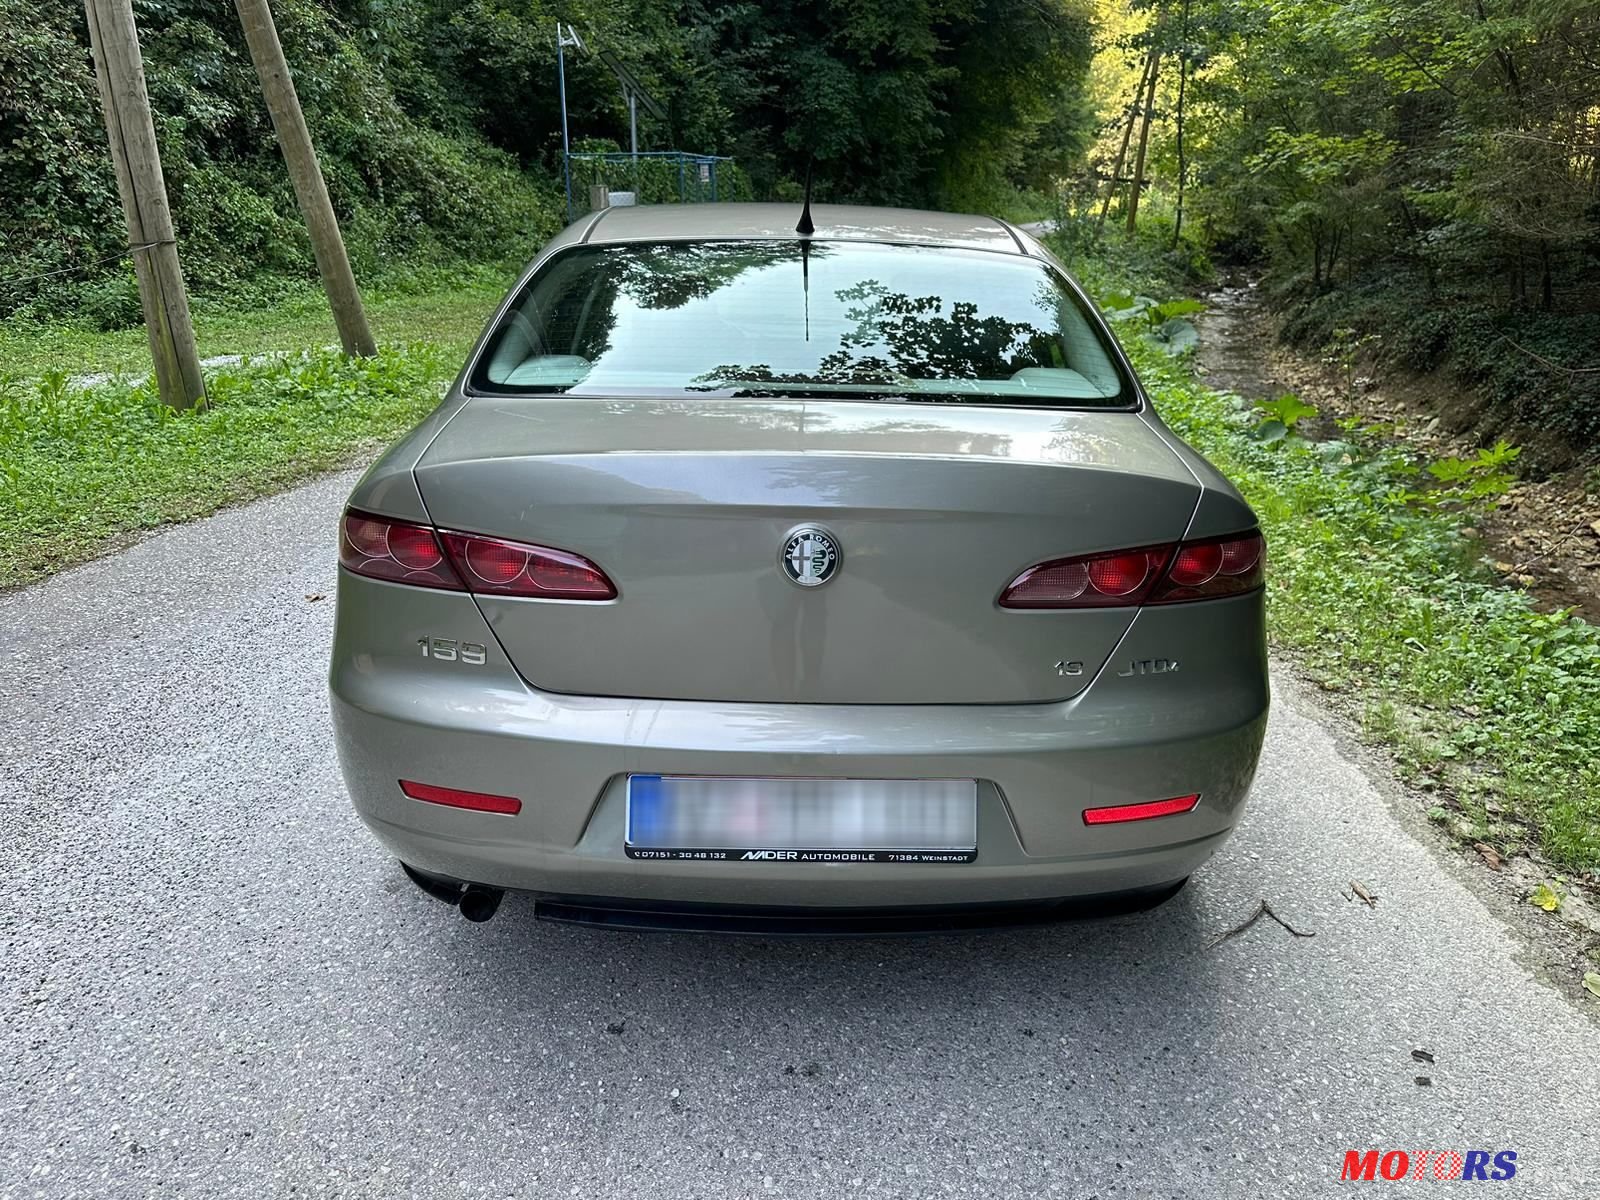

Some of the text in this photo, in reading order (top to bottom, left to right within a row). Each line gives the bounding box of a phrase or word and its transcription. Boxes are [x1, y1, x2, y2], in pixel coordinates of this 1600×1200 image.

[785, 533, 835, 560] ALFA ROMEO
[417, 635, 486, 665] 159
[801, 853, 876, 861] AUTOMOBILE
